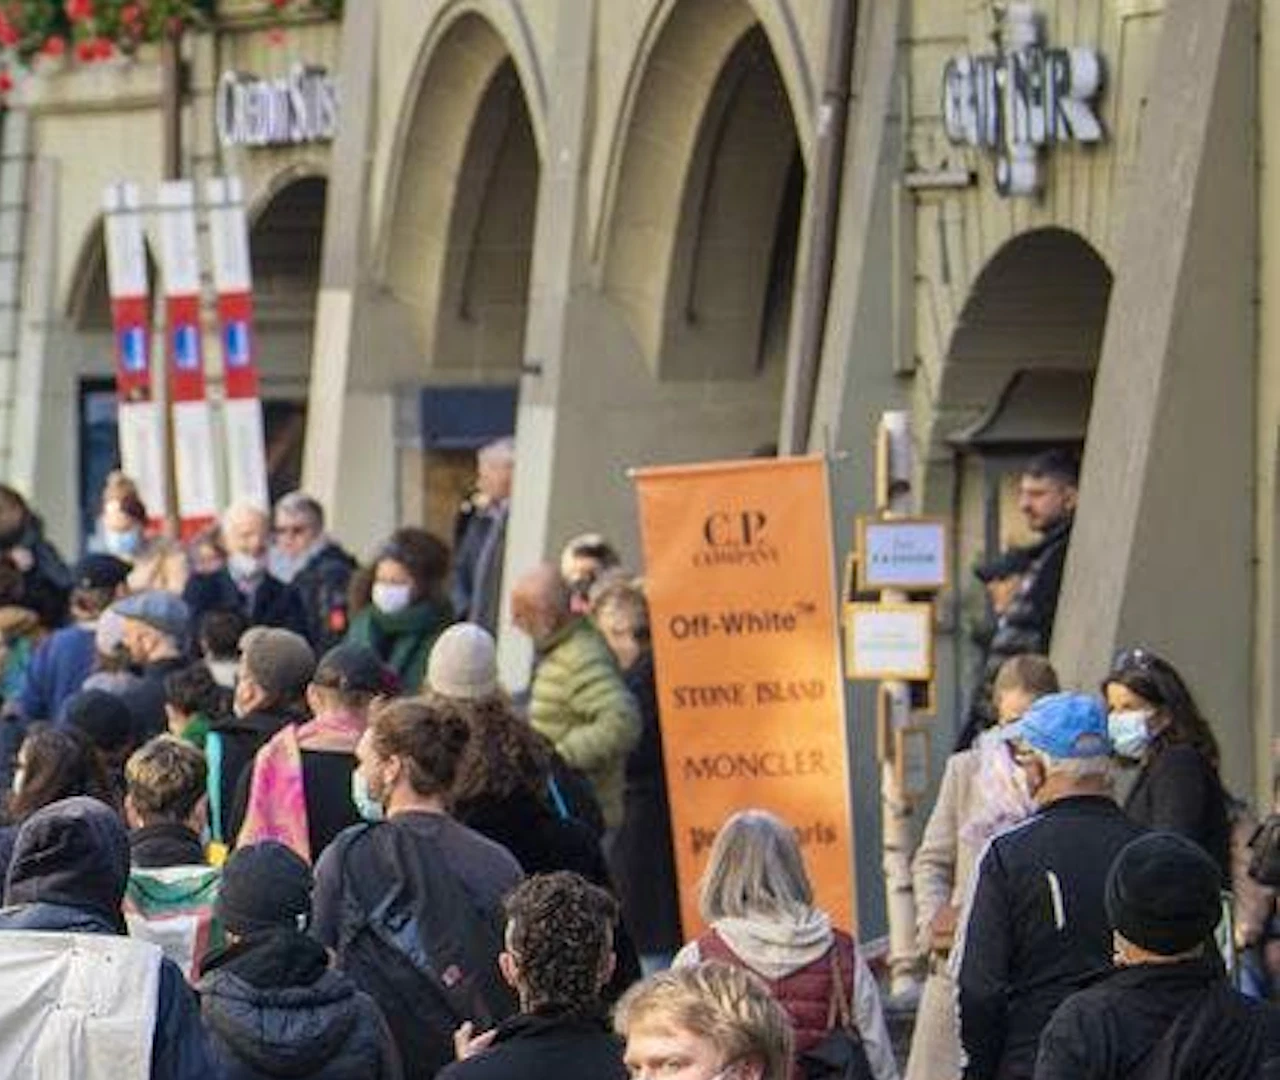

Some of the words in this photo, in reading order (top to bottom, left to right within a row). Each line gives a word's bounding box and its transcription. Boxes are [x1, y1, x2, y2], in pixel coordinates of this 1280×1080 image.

[673, 682, 744, 710] STONE
[754, 678, 826, 705] ISLAND
[682, 749, 831, 782] MONCLER
